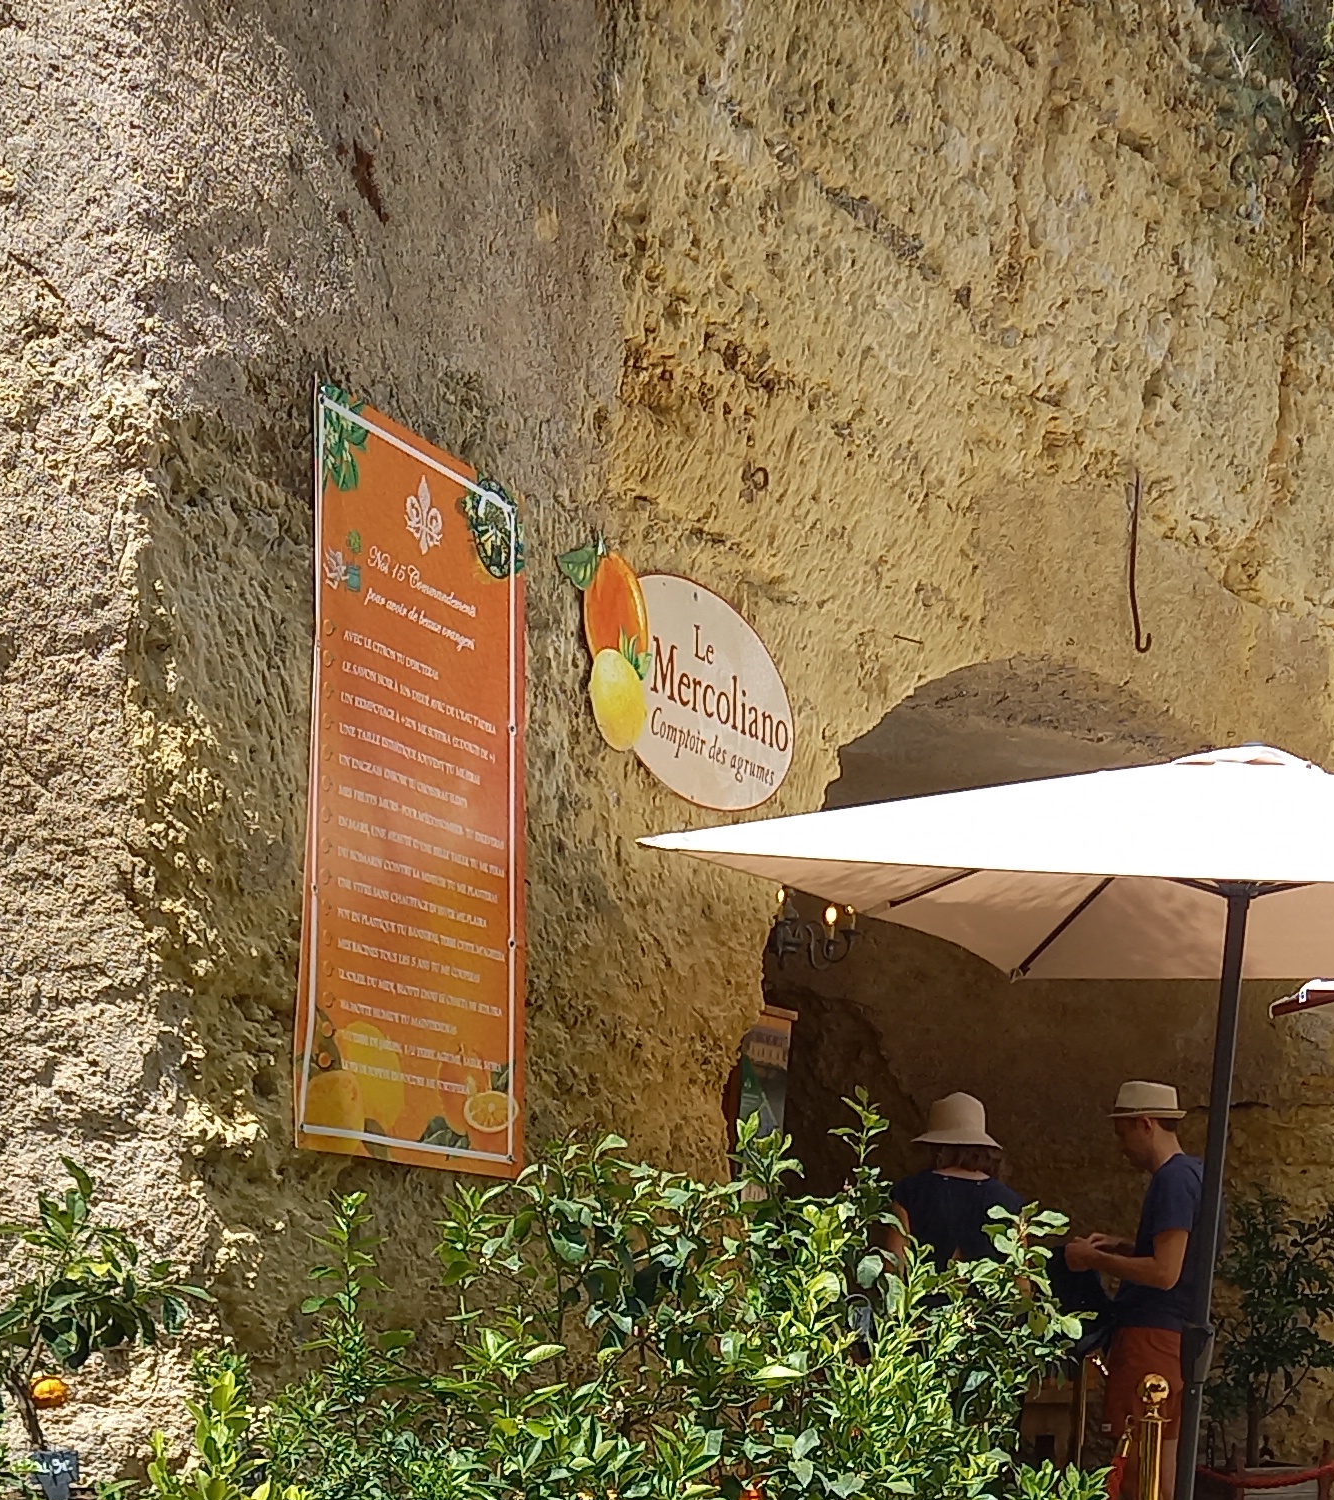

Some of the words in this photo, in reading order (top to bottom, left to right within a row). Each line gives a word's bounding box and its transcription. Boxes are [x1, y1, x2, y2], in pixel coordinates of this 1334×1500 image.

[392, 562, 406, 583] 15
[694, 624, 714, 664] Le
[651, 635, 789, 752] Mercoliano
[651, 707, 706, 759] Comptoir
[708, 736, 727, 765] des
[730, 754, 775, 787] agrumes
